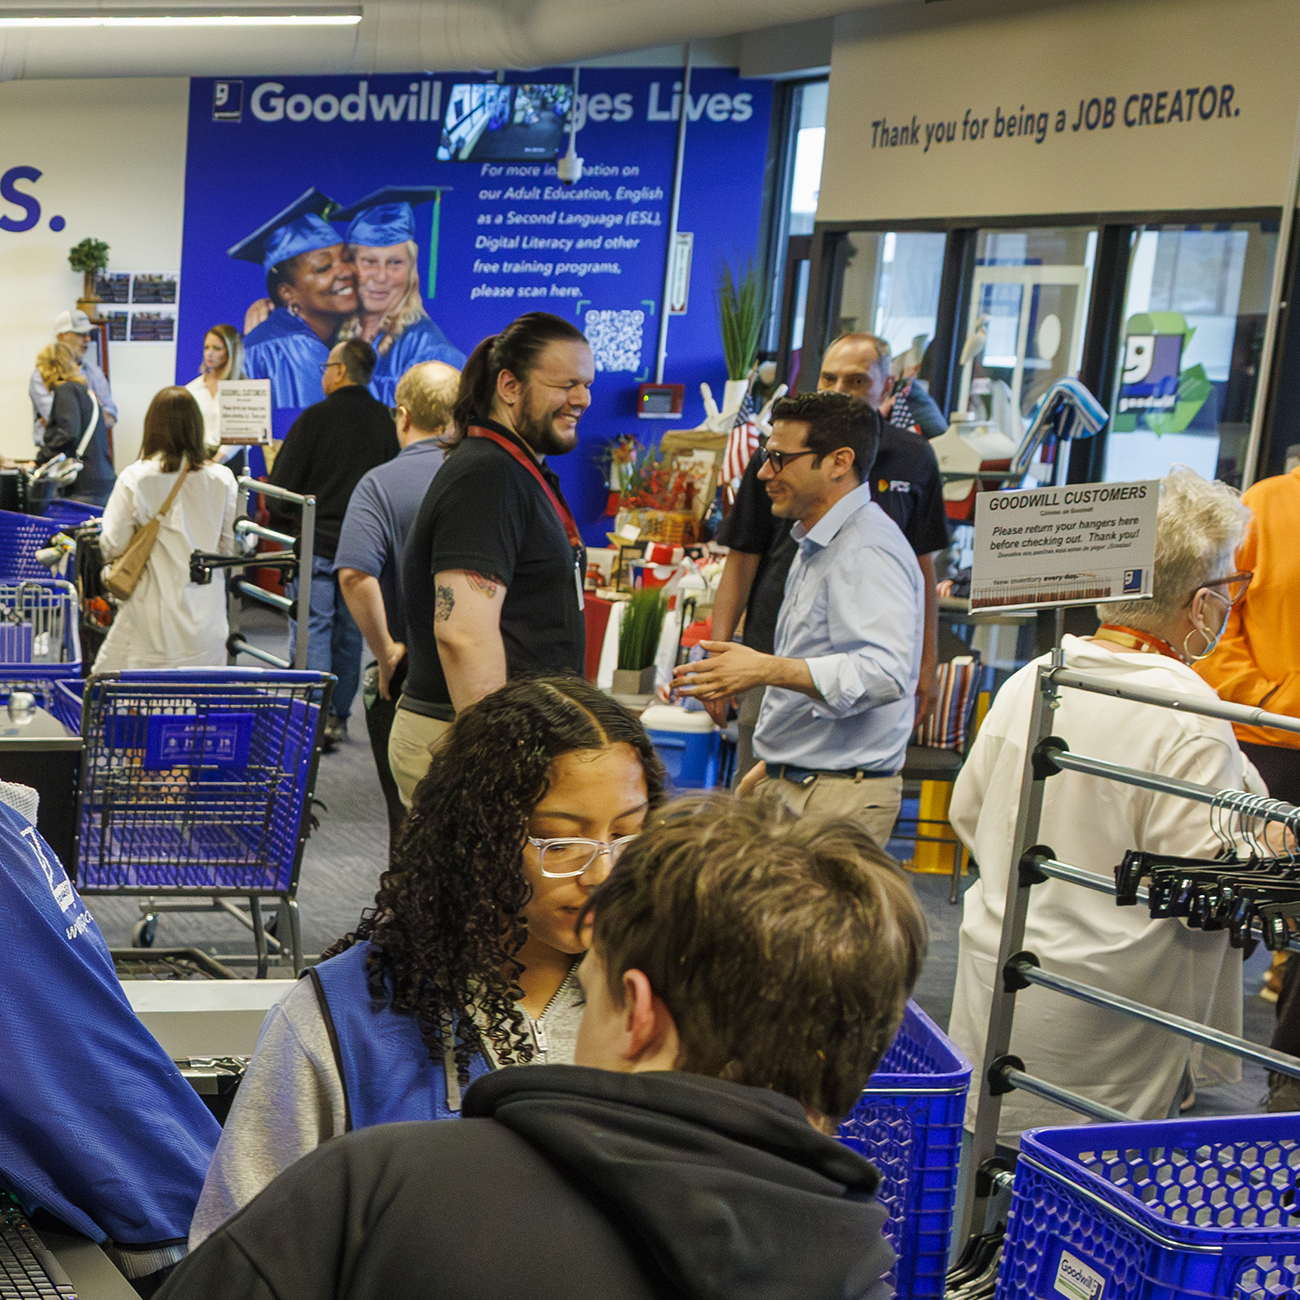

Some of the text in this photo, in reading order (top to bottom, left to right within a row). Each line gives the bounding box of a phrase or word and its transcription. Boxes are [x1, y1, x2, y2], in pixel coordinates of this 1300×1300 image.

[250, 81, 442, 122] Goodwill
[647, 82, 753, 122] Lives
[871, 83, 1241, 154] Thank you for being a JOB CREATOR.
[481, 163, 502, 177] For
[506, 166, 540, 177] more
[622, 166, 640, 177] on
[478, 186, 664, 203] our Adult Education, English
[477, 214, 492, 225] as
[494, 214, 503, 225] a
[506, 210, 556, 225] Second
[558, 211, 624, 228] Language
[475, 235, 641, 252] Digital Literacy and other
[473, 259, 622, 277] free training programs,
[470, 283, 583, 300] please scan here.
[989, 485, 1147, 511] GOODWILL CUSTOMERS
[992, 516, 1139, 537] Please return your hangers here
[990, 539, 1019, 550] before
[1022, 535, 1063, 548] checking
[1066, 535, 1083, 544] out.
[1088, 531, 1116, 542] Thank
[1119, 529, 1140, 541] you!
